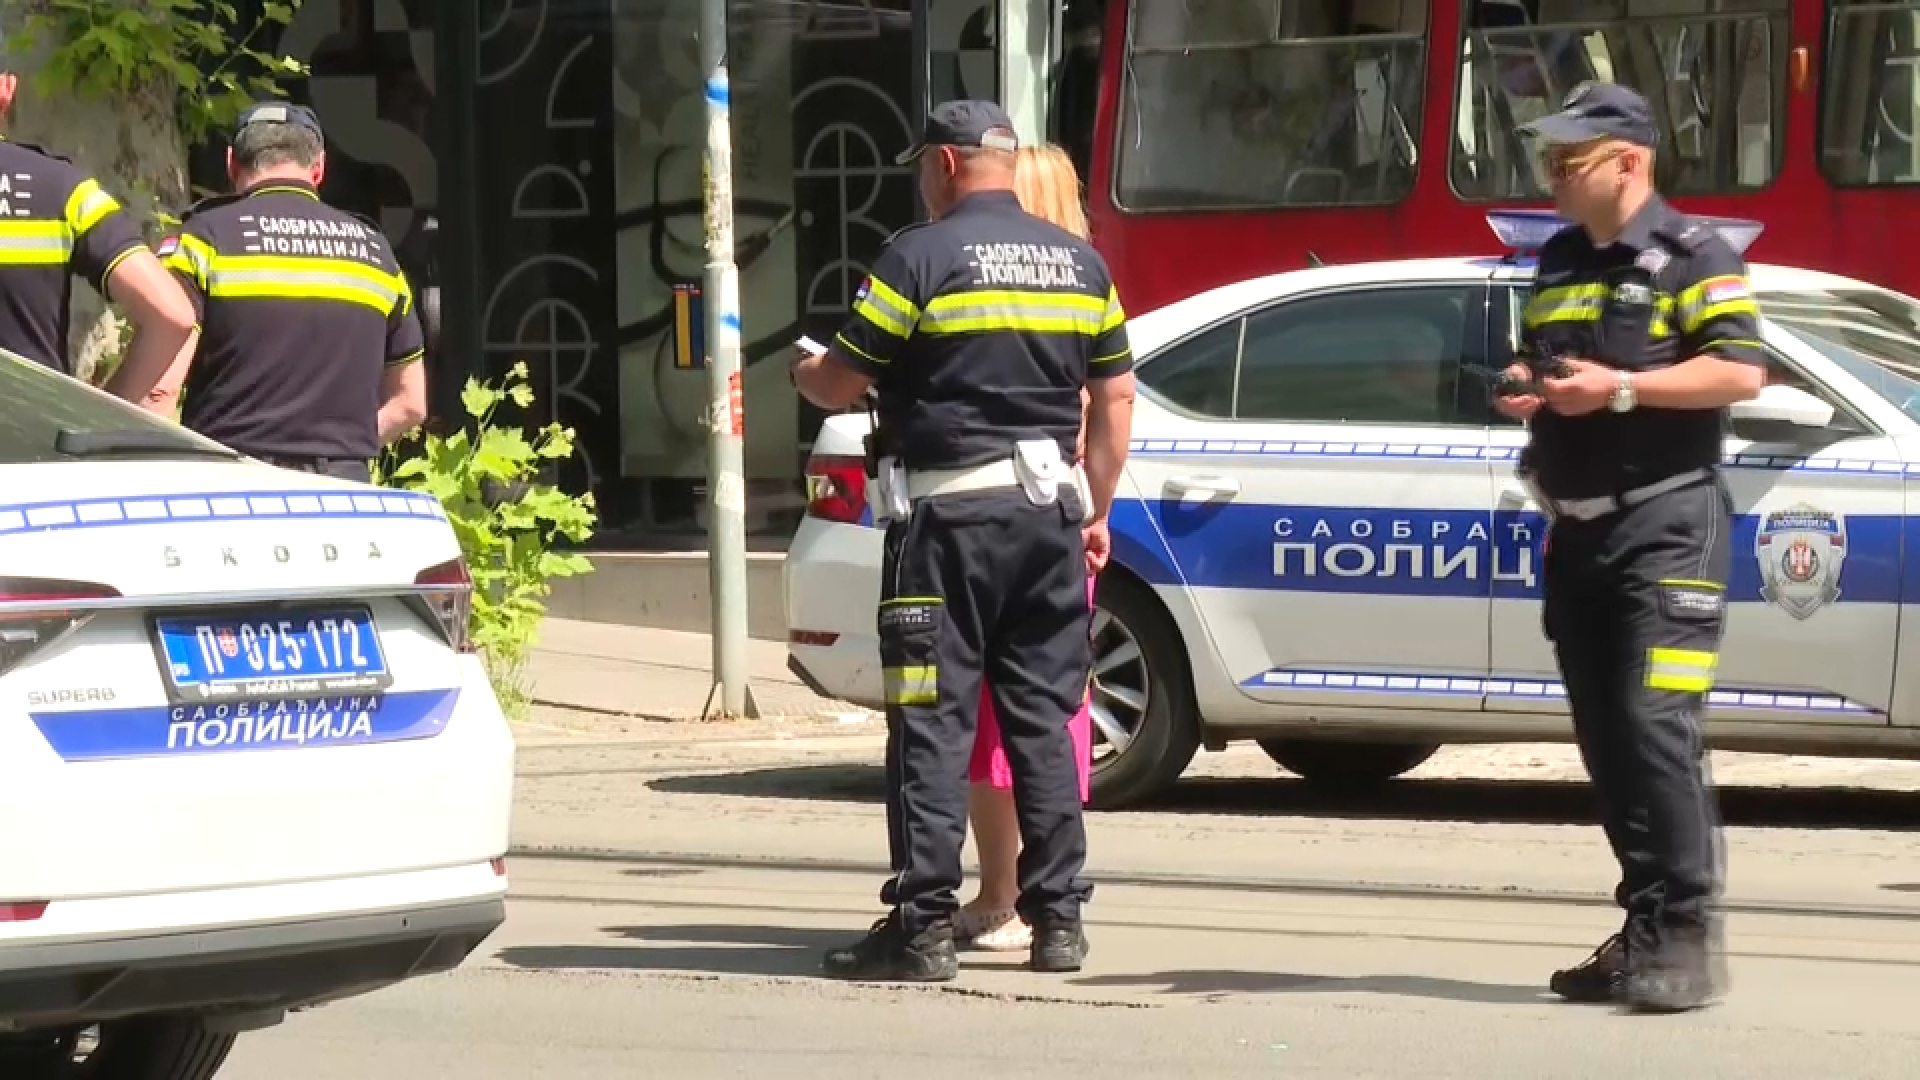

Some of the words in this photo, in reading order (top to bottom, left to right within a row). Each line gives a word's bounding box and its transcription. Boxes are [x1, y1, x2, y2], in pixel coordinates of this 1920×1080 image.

[259, 215, 366, 240] САОБРАЋАЈНА
[262, 236, 368, 260] ПОЛИЦИЈА
[981, 262, 1079, 288] ПОЛИЦИЈА
[1273, 517, 1532, 541] САОБРАЋ
[1273, 541, 1536, 587] ПОЛИЦ
[27, 687, 117, 706] SUPERB
[171, 696, 378, 721] САОБРАЋАЈНА
[167, 711, 372, 749] ПОЛИЦИЈА
